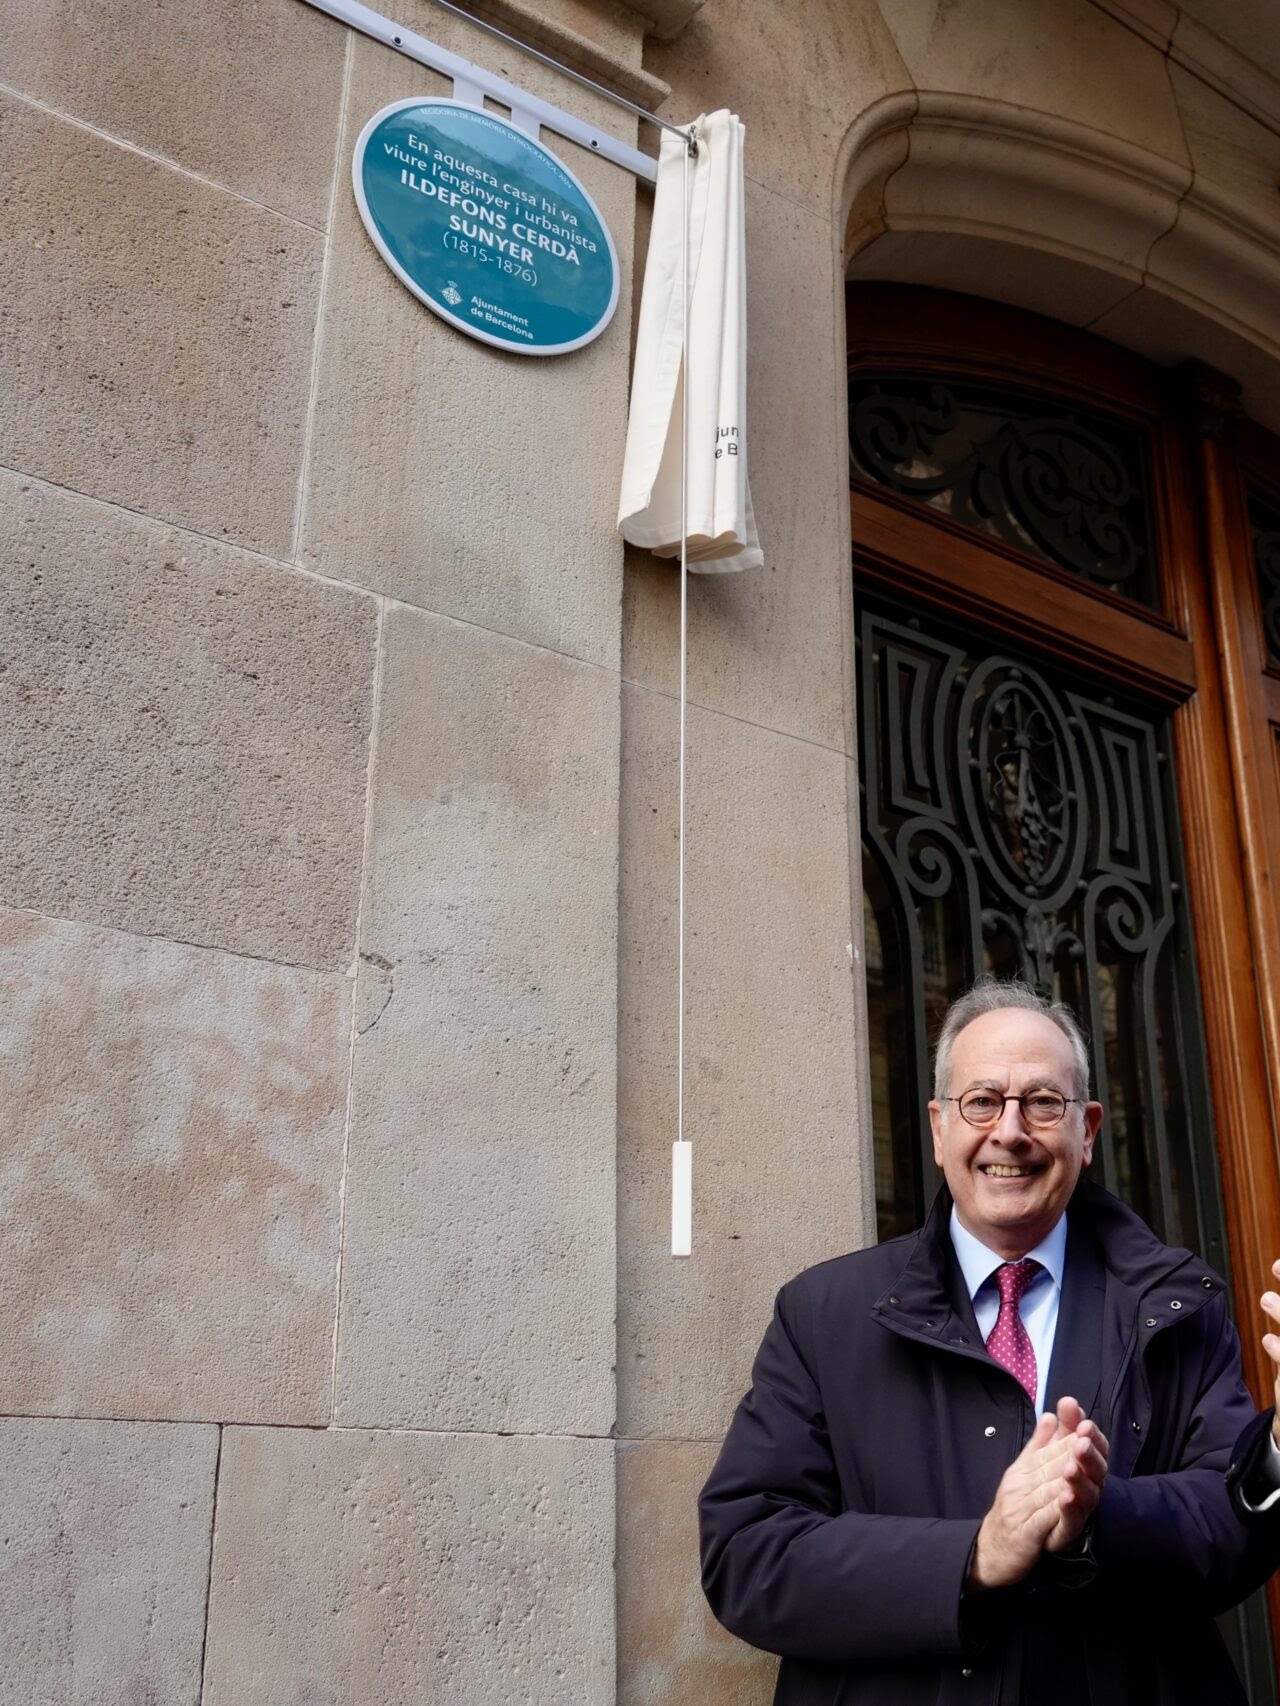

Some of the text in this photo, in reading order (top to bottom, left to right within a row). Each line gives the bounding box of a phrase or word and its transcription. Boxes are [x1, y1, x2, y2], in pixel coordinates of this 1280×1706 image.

[384, 143, 428, 171] viure
[515, 204, 521, 215] i
[525, 210, 597, 253] urbanista
[407, 134, 579, 227] En aquesta casa hi va
[401, 169, 581, 266] ILDEFONS CERDÀ
[450, 214, 534, 266] SUNYER
[443, 231, 538, 287] (1815-1876)
[471, 296, 529, 327] Ajuntament
[471, 307, 534, 340] de Barcelona
